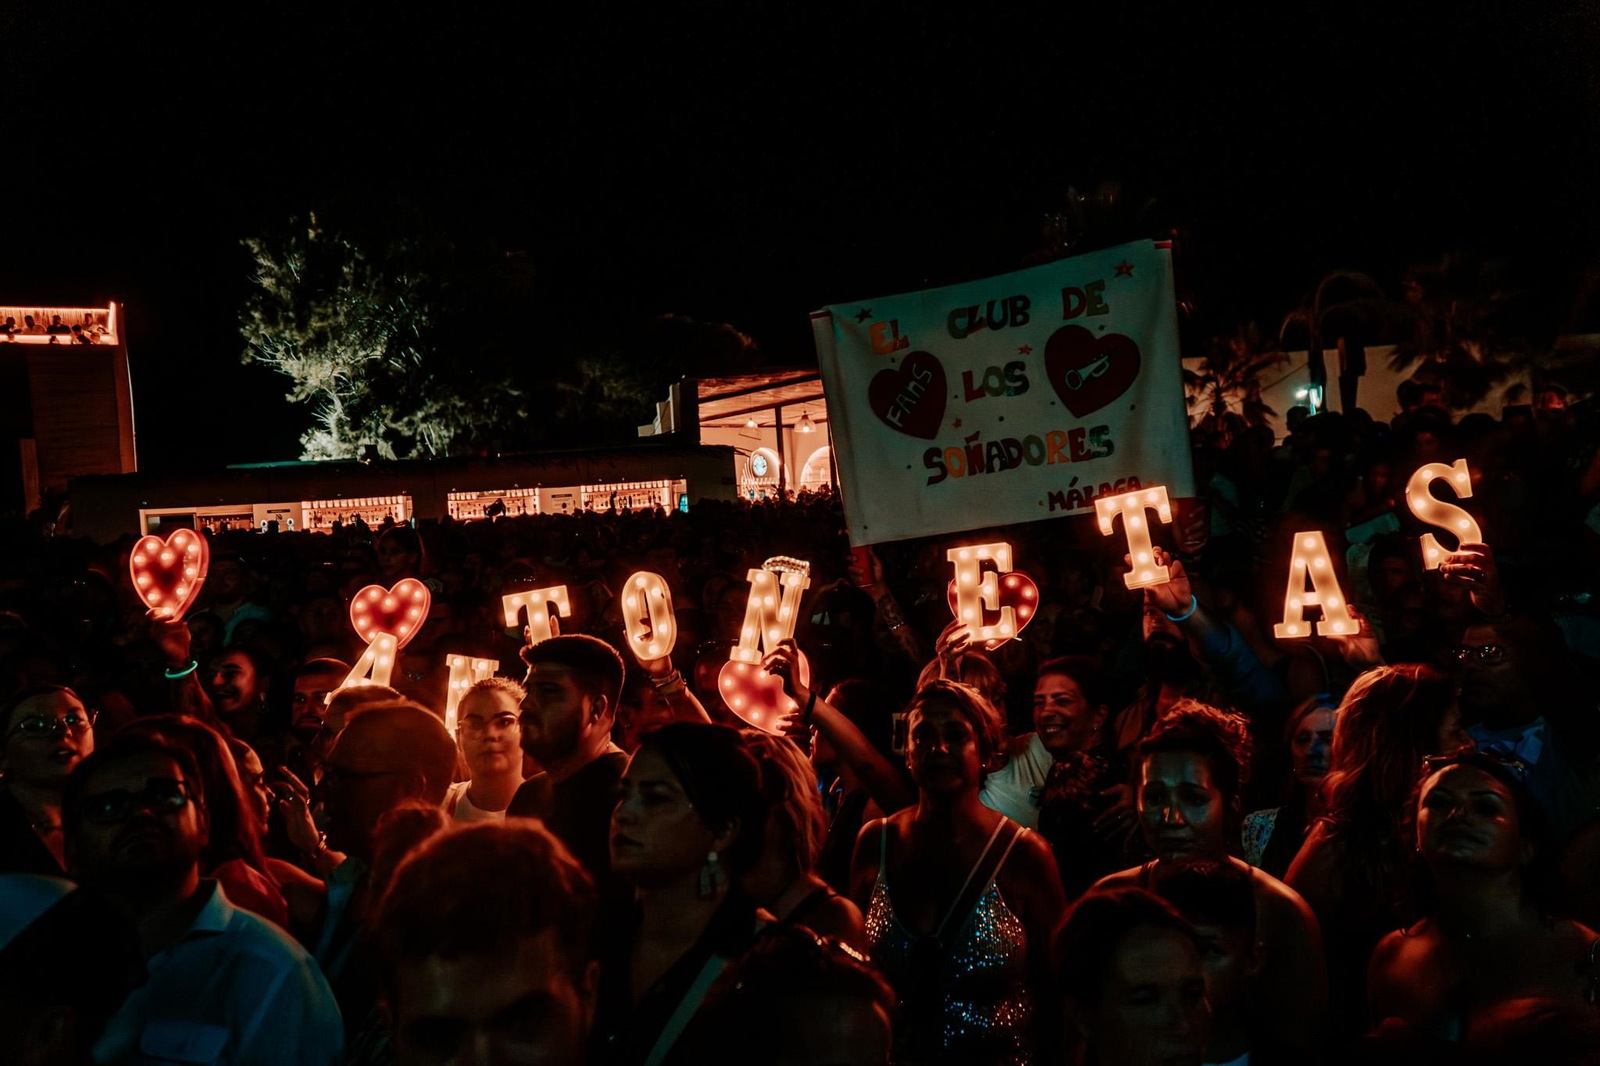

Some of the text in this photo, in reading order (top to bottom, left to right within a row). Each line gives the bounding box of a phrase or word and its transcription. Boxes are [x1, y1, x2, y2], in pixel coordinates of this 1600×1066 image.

[870, 279, 1110, 355] EL CLUB DE
[963, 361, 1029, 402] LOS
[923, 425, 1115, 486] SOÑADORES
